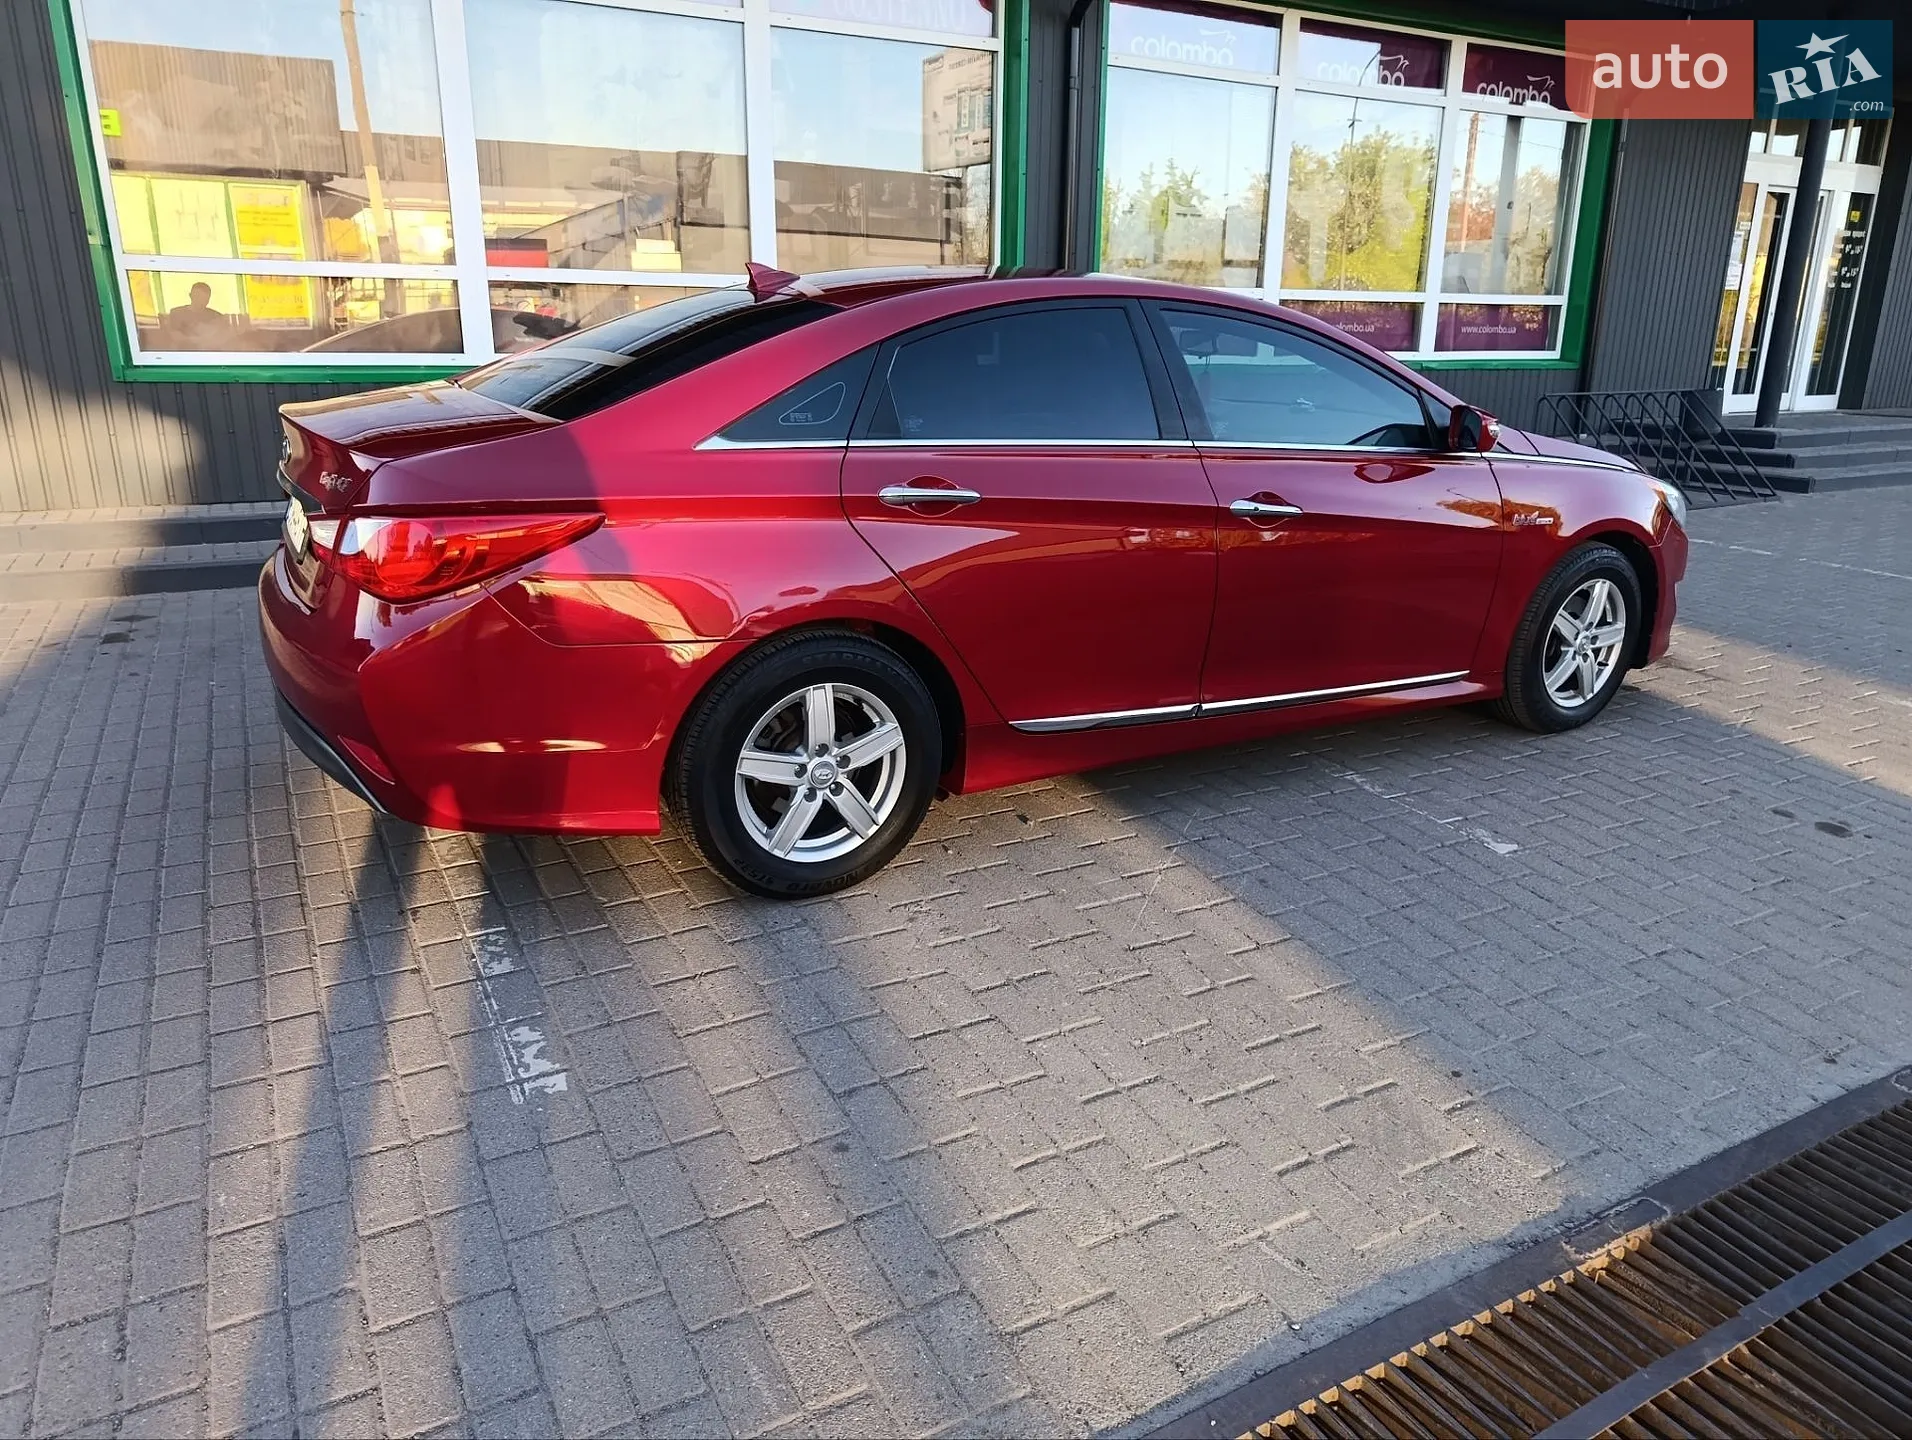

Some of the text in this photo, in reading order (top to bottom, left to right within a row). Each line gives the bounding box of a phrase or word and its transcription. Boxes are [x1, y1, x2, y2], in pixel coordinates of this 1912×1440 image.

[1131, 35, 1234, 66] colombo
[1477, 81, 1551, 105] colombo
[1461, 324, 1517, 334] www.colombo.ua
